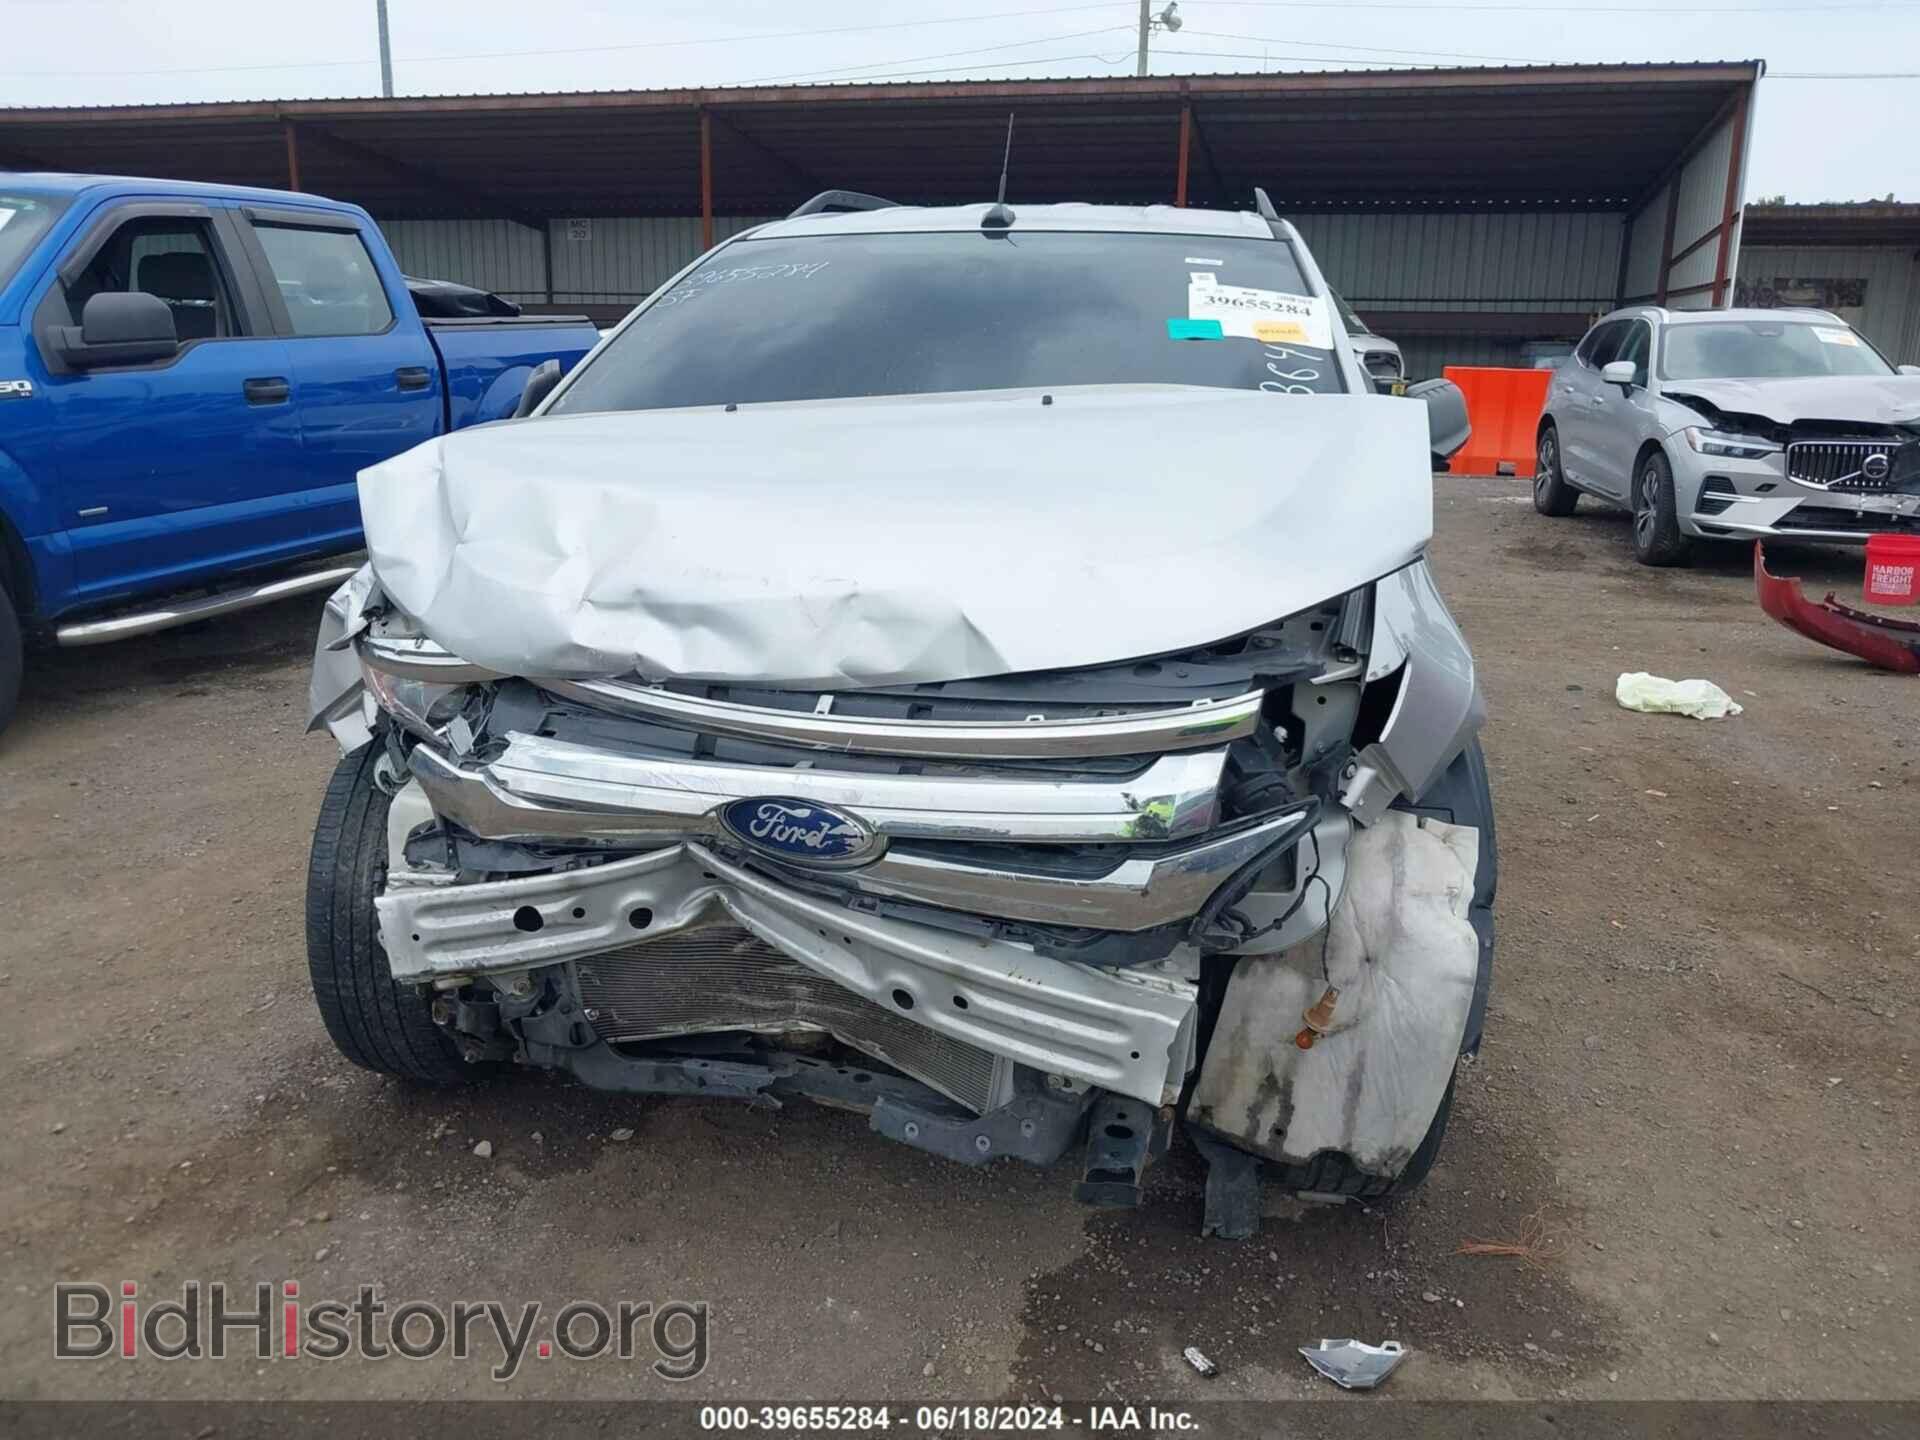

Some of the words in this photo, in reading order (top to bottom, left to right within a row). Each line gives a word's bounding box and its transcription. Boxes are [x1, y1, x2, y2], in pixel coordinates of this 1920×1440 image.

[1203, 295, 1313, 317] 39655284
[1873, 564, 1914, 576] HARBOR
[1872, 573, 1912, 585] FREIGHT
[750, 803, 832, 849] Ford
